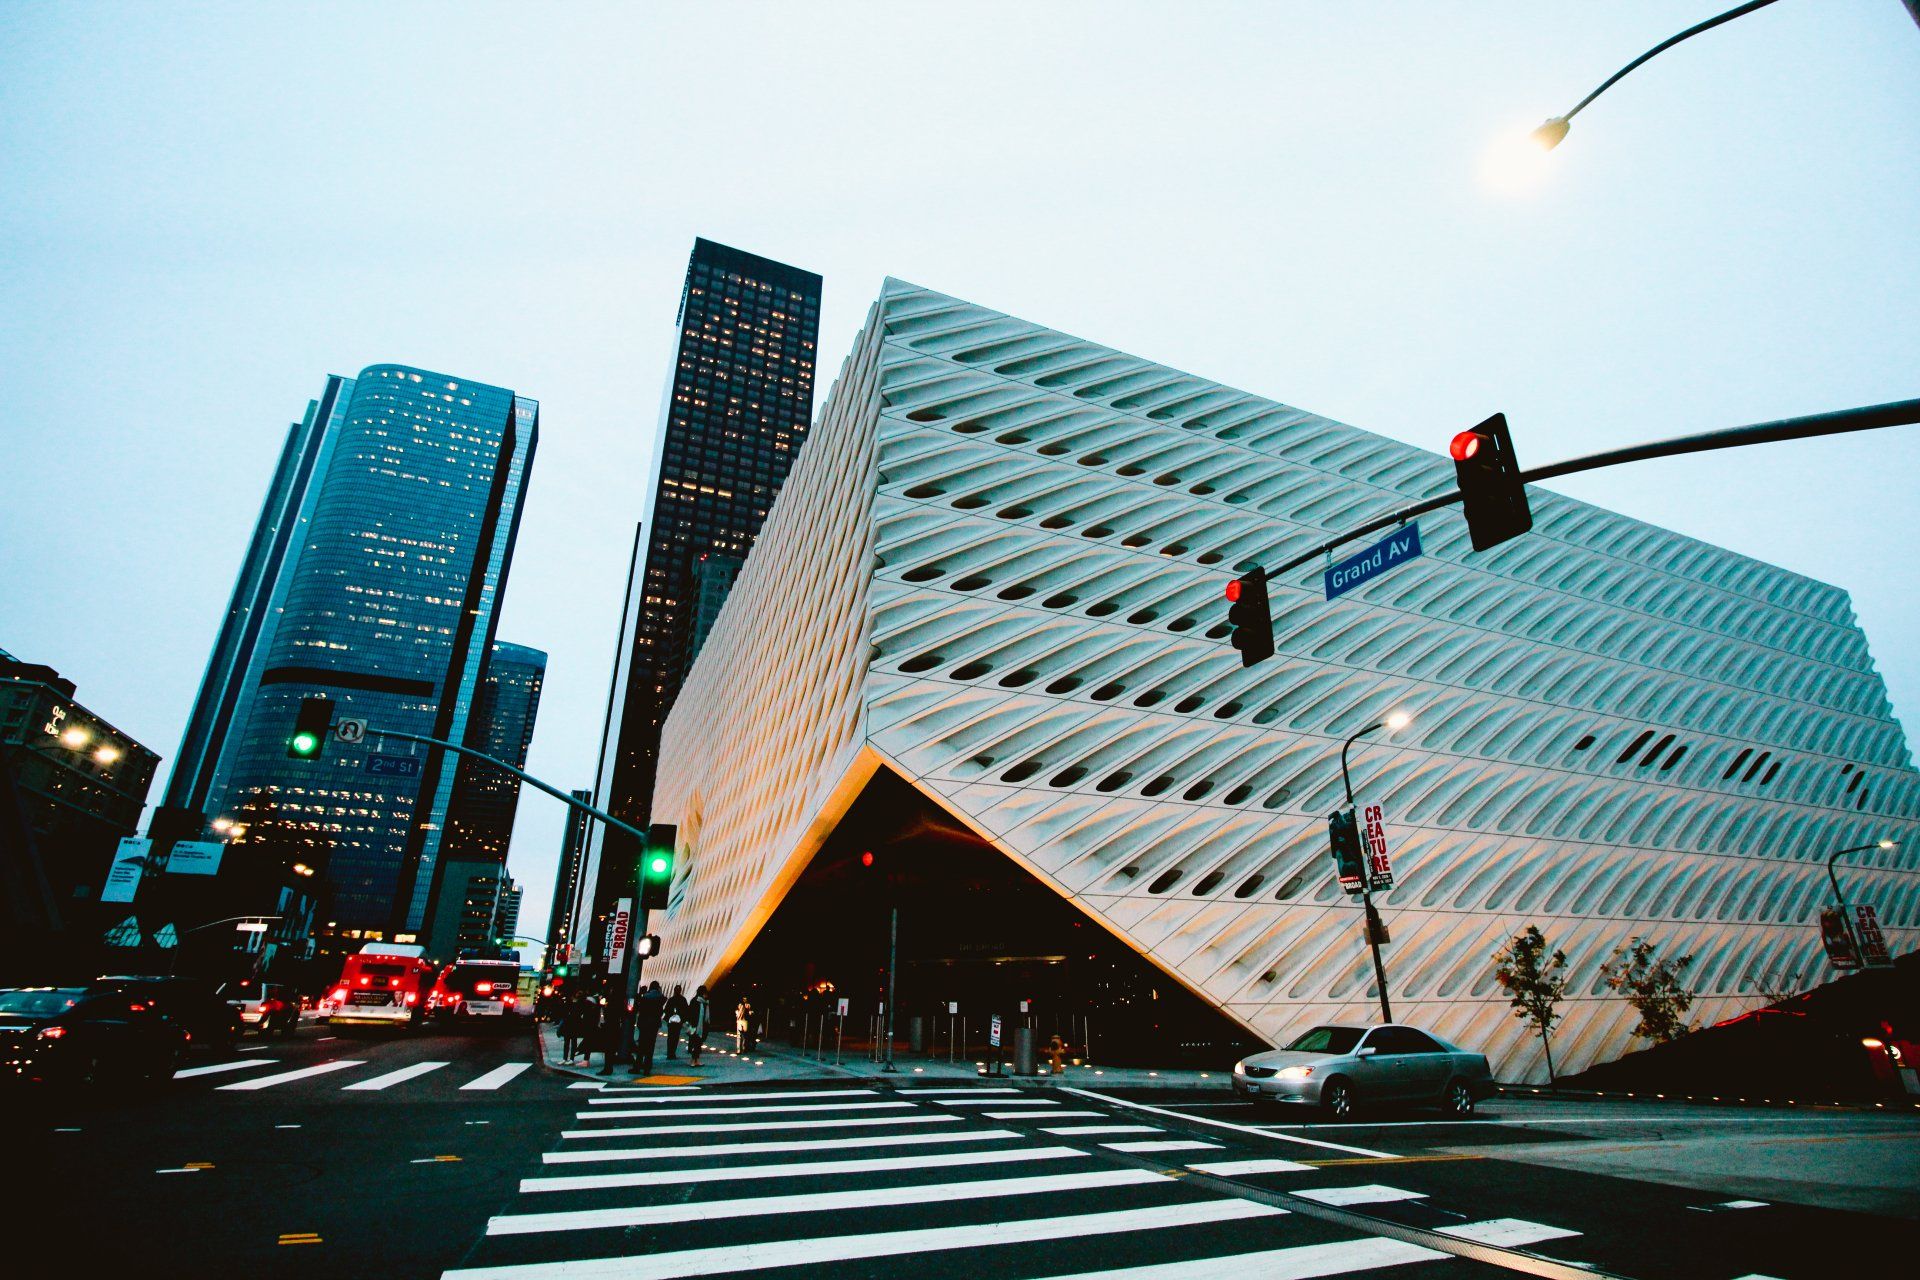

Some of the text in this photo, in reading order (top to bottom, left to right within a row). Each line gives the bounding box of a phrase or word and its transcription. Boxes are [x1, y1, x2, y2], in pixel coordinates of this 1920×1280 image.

[1332, 537, 1410, 588] Grand Av
[372, 759, 412, 773] 2nd St
[1365, 806, 1382, 822] CR
[1367, 822, 1384, 839] EA
[1370, 839, 1387, 855] TU
[1373, 855, 1390, 872] RE
[613, 912, 628, 948] BROAD
